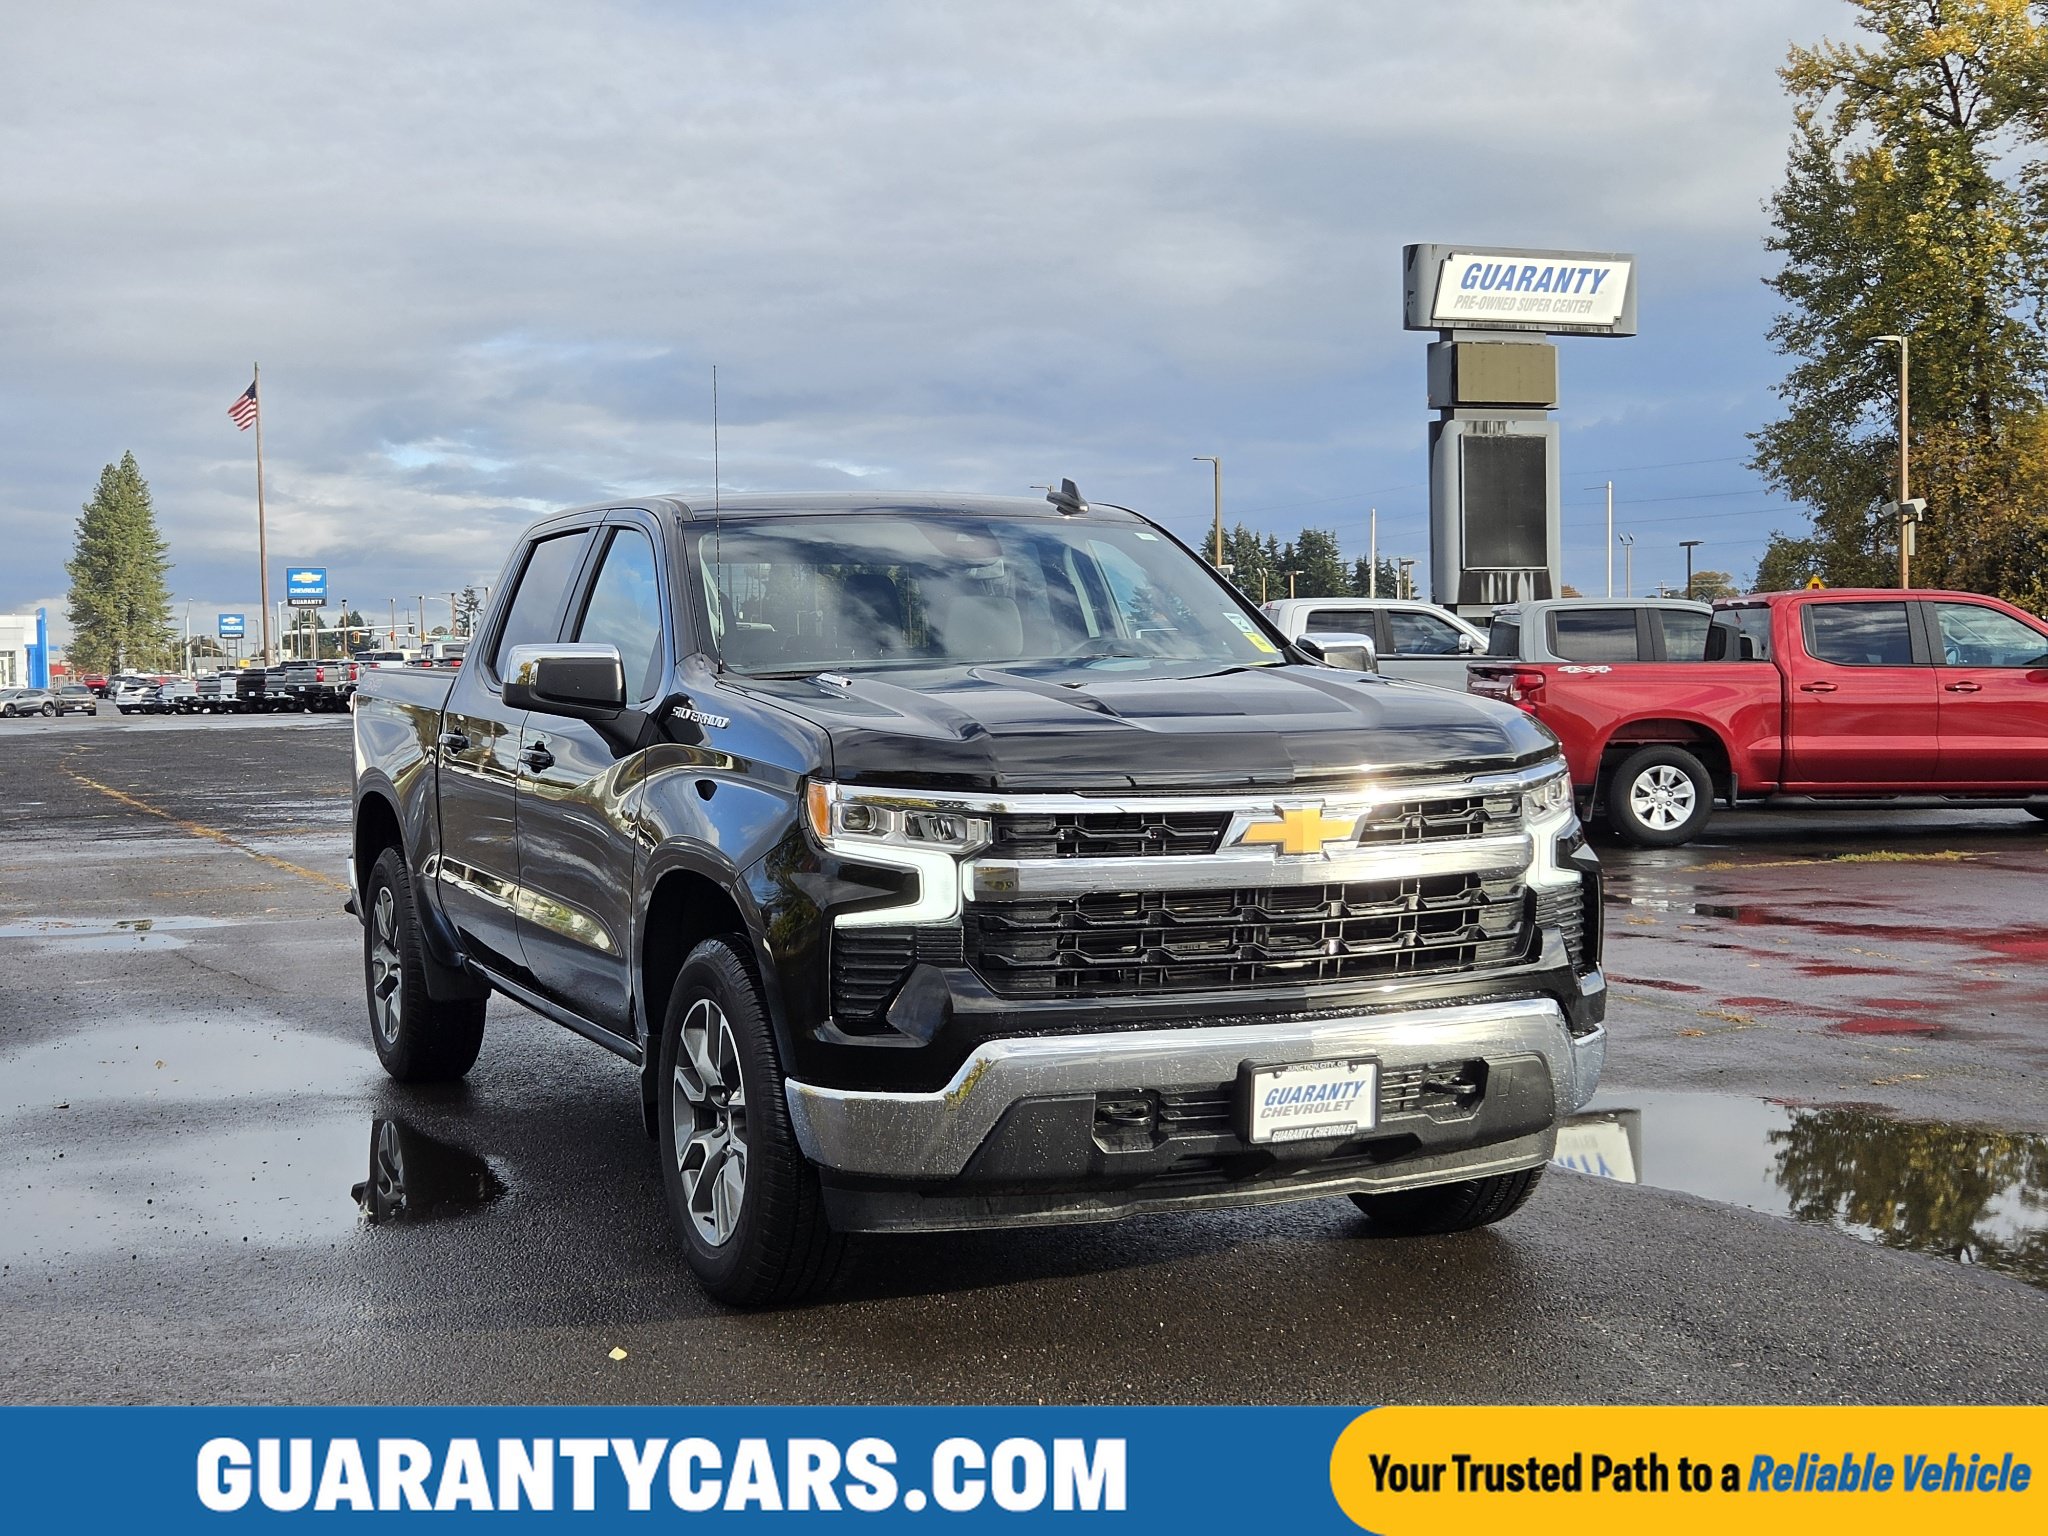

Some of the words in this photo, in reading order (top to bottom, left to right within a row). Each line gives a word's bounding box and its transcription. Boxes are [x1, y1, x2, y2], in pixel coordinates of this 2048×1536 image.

[1460, 262, 1610, 295] GUARANTY
[1453, 294, 1517, 311] PRE-OWNED
[1516, 297, 1552, 312] SUPER
[1552, 299, 1594, 315] CENTER
[1336, 1060, 1349, 1068] OR
[1264, 1080, 1367, 1108] GUARANTY
[1260, 1100, 1355, 1119] CHEVROLET
[1271, 1127, 1314, 1143] GUARANTY
[1312, 1123, 1357, 1139] CHEVROLET
